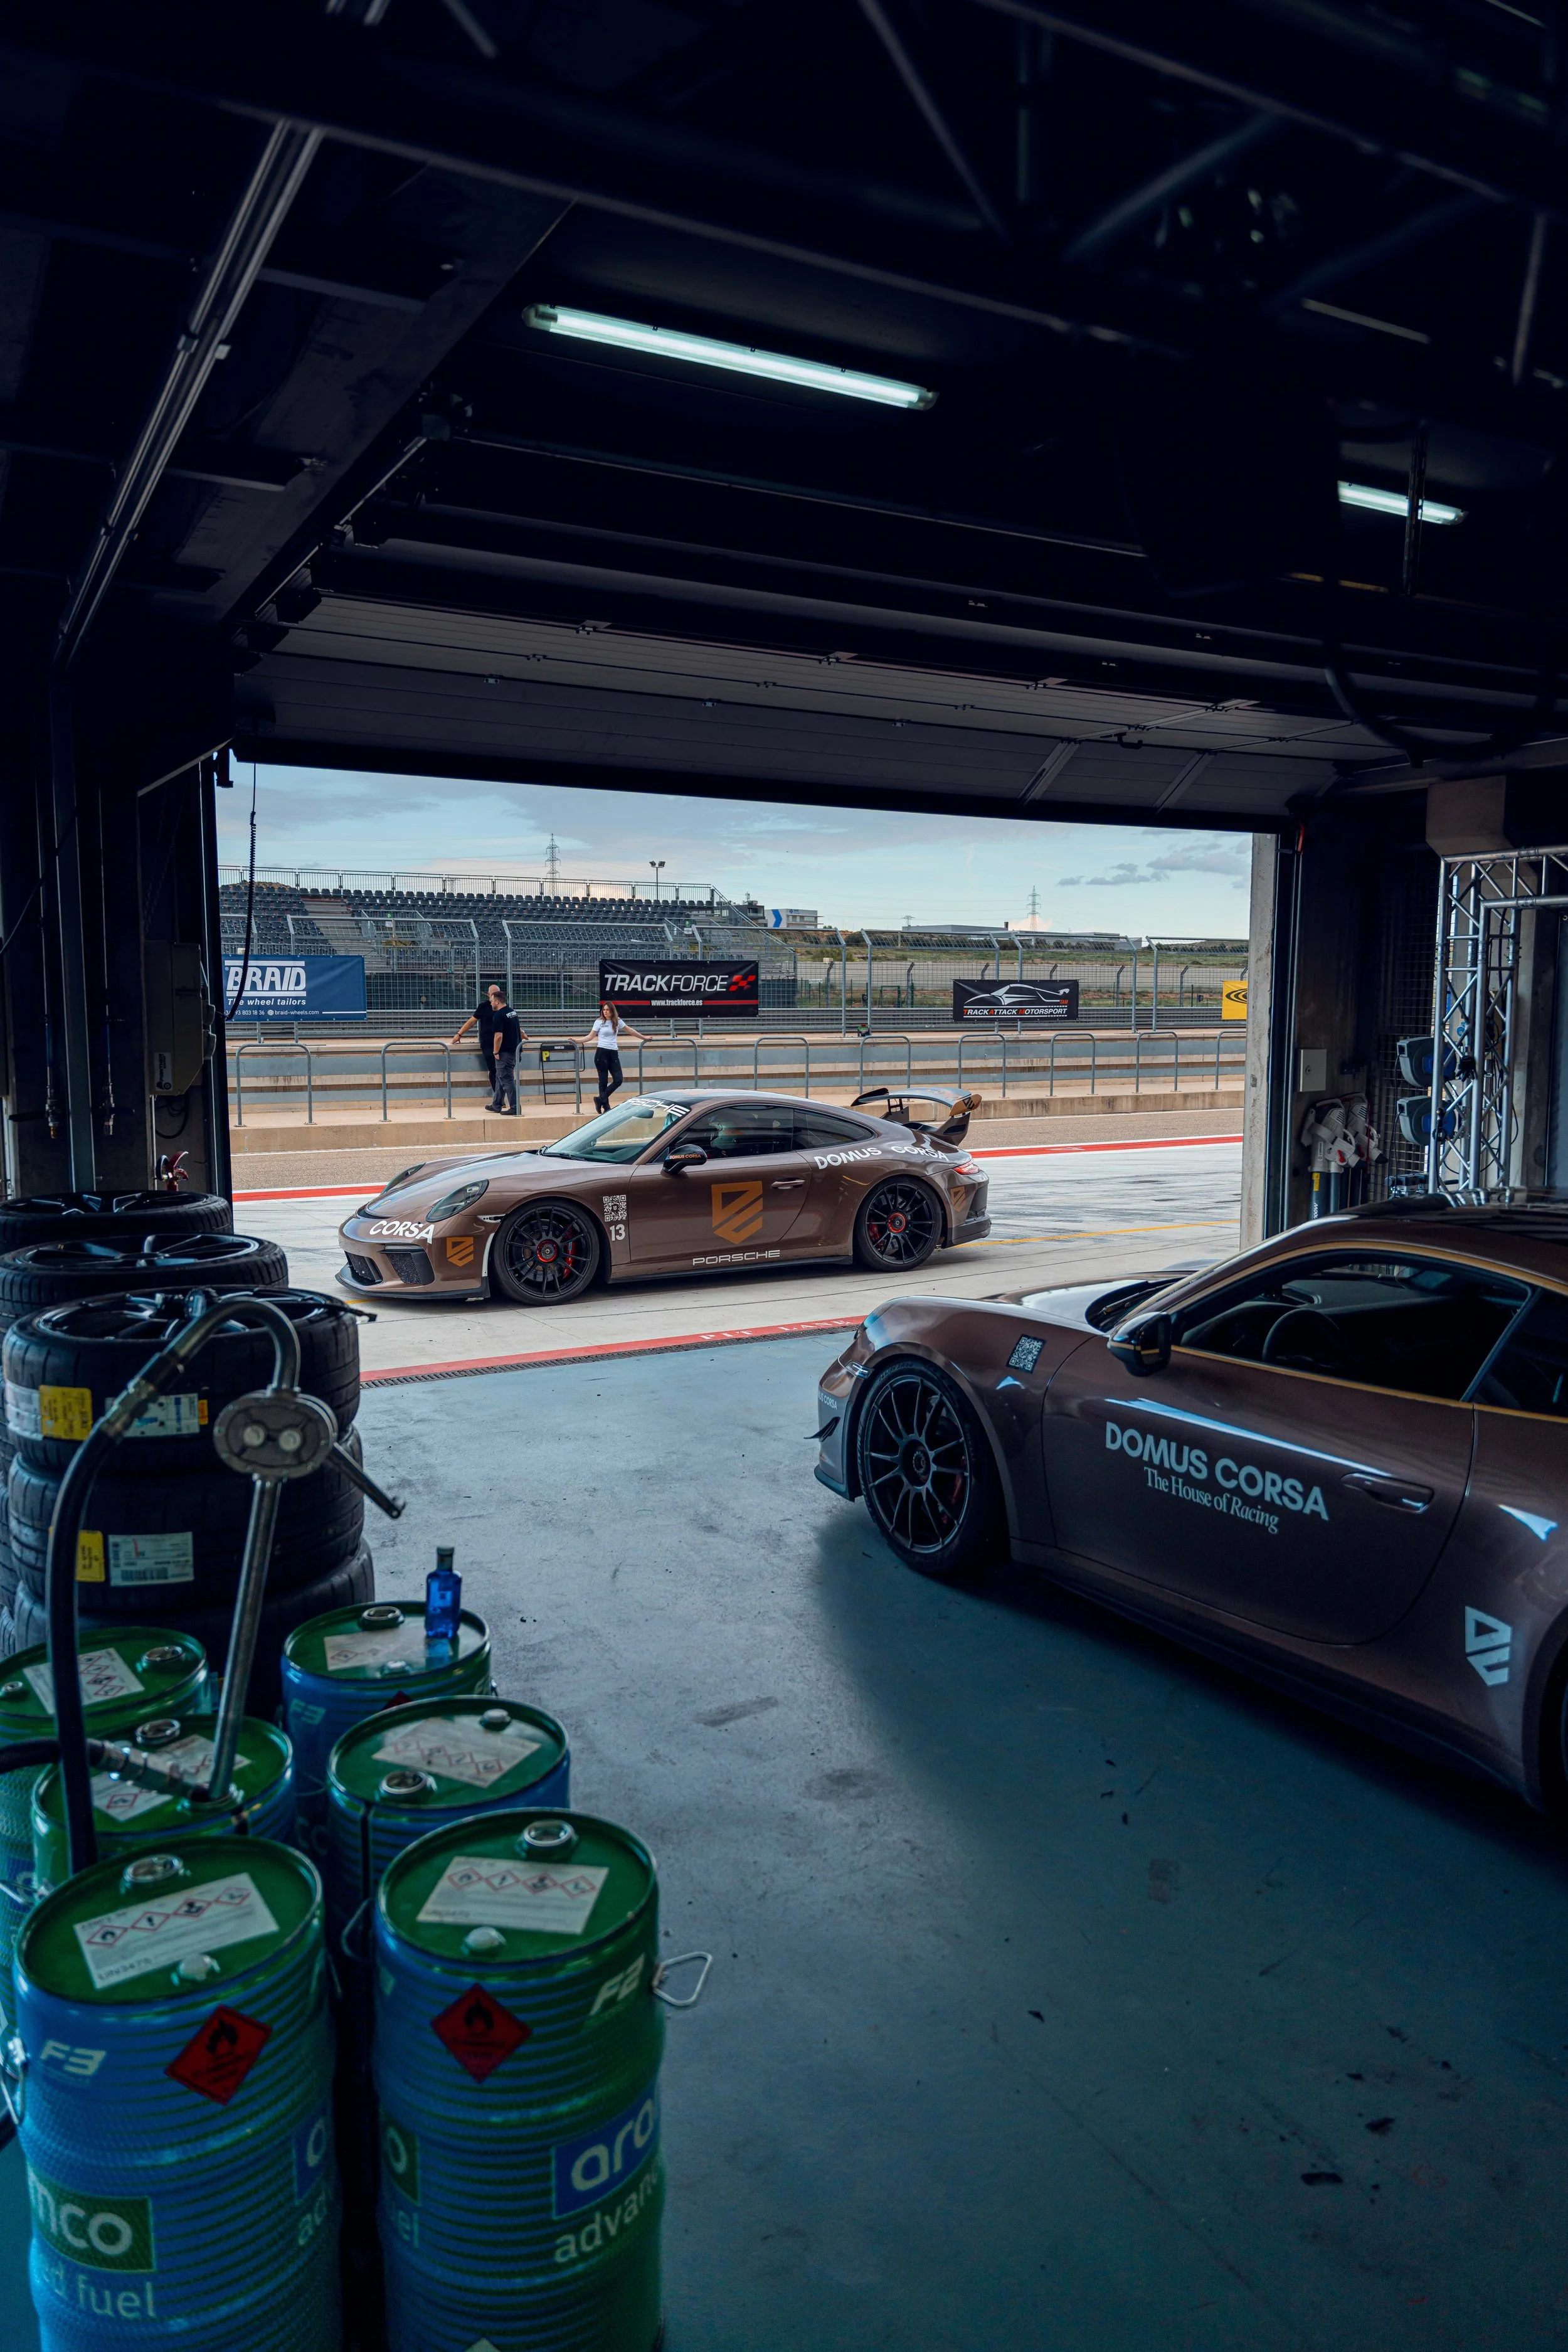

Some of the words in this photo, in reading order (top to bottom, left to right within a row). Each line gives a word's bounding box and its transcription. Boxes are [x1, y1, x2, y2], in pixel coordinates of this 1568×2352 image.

[226, 967, 306, 991] BRAID
[604, 974, 729, 991] TRACKFORCE
[542, 1051, 550, 1062] P
[813, 1147, 882, 1170] DOMUS
[891, 1146, 949, 1162] CORSA
[369, 1219, 435, 1244] CORSA
[610, 1224, 625, 1242] 13
[692, 1249, 780, 1266] PORSCHE
[698, 1330, 753, 1340] PIT
[778, 1320, 854, 1331] LANE
[1105, 1421, 1208, 1480] DOMUS
[1215, 1458, 1329, 1521] CORSA
[1144, 1466, 1169, 1493] The
[1171, 1475, 1212, 1507] House
[1214, 1492, 1230, 1512] of
[1230, 1496, 1279, 1535] Racing
[39, 2040, 107, 2076] F3
[77, 2273, 157, 2318] fuel
